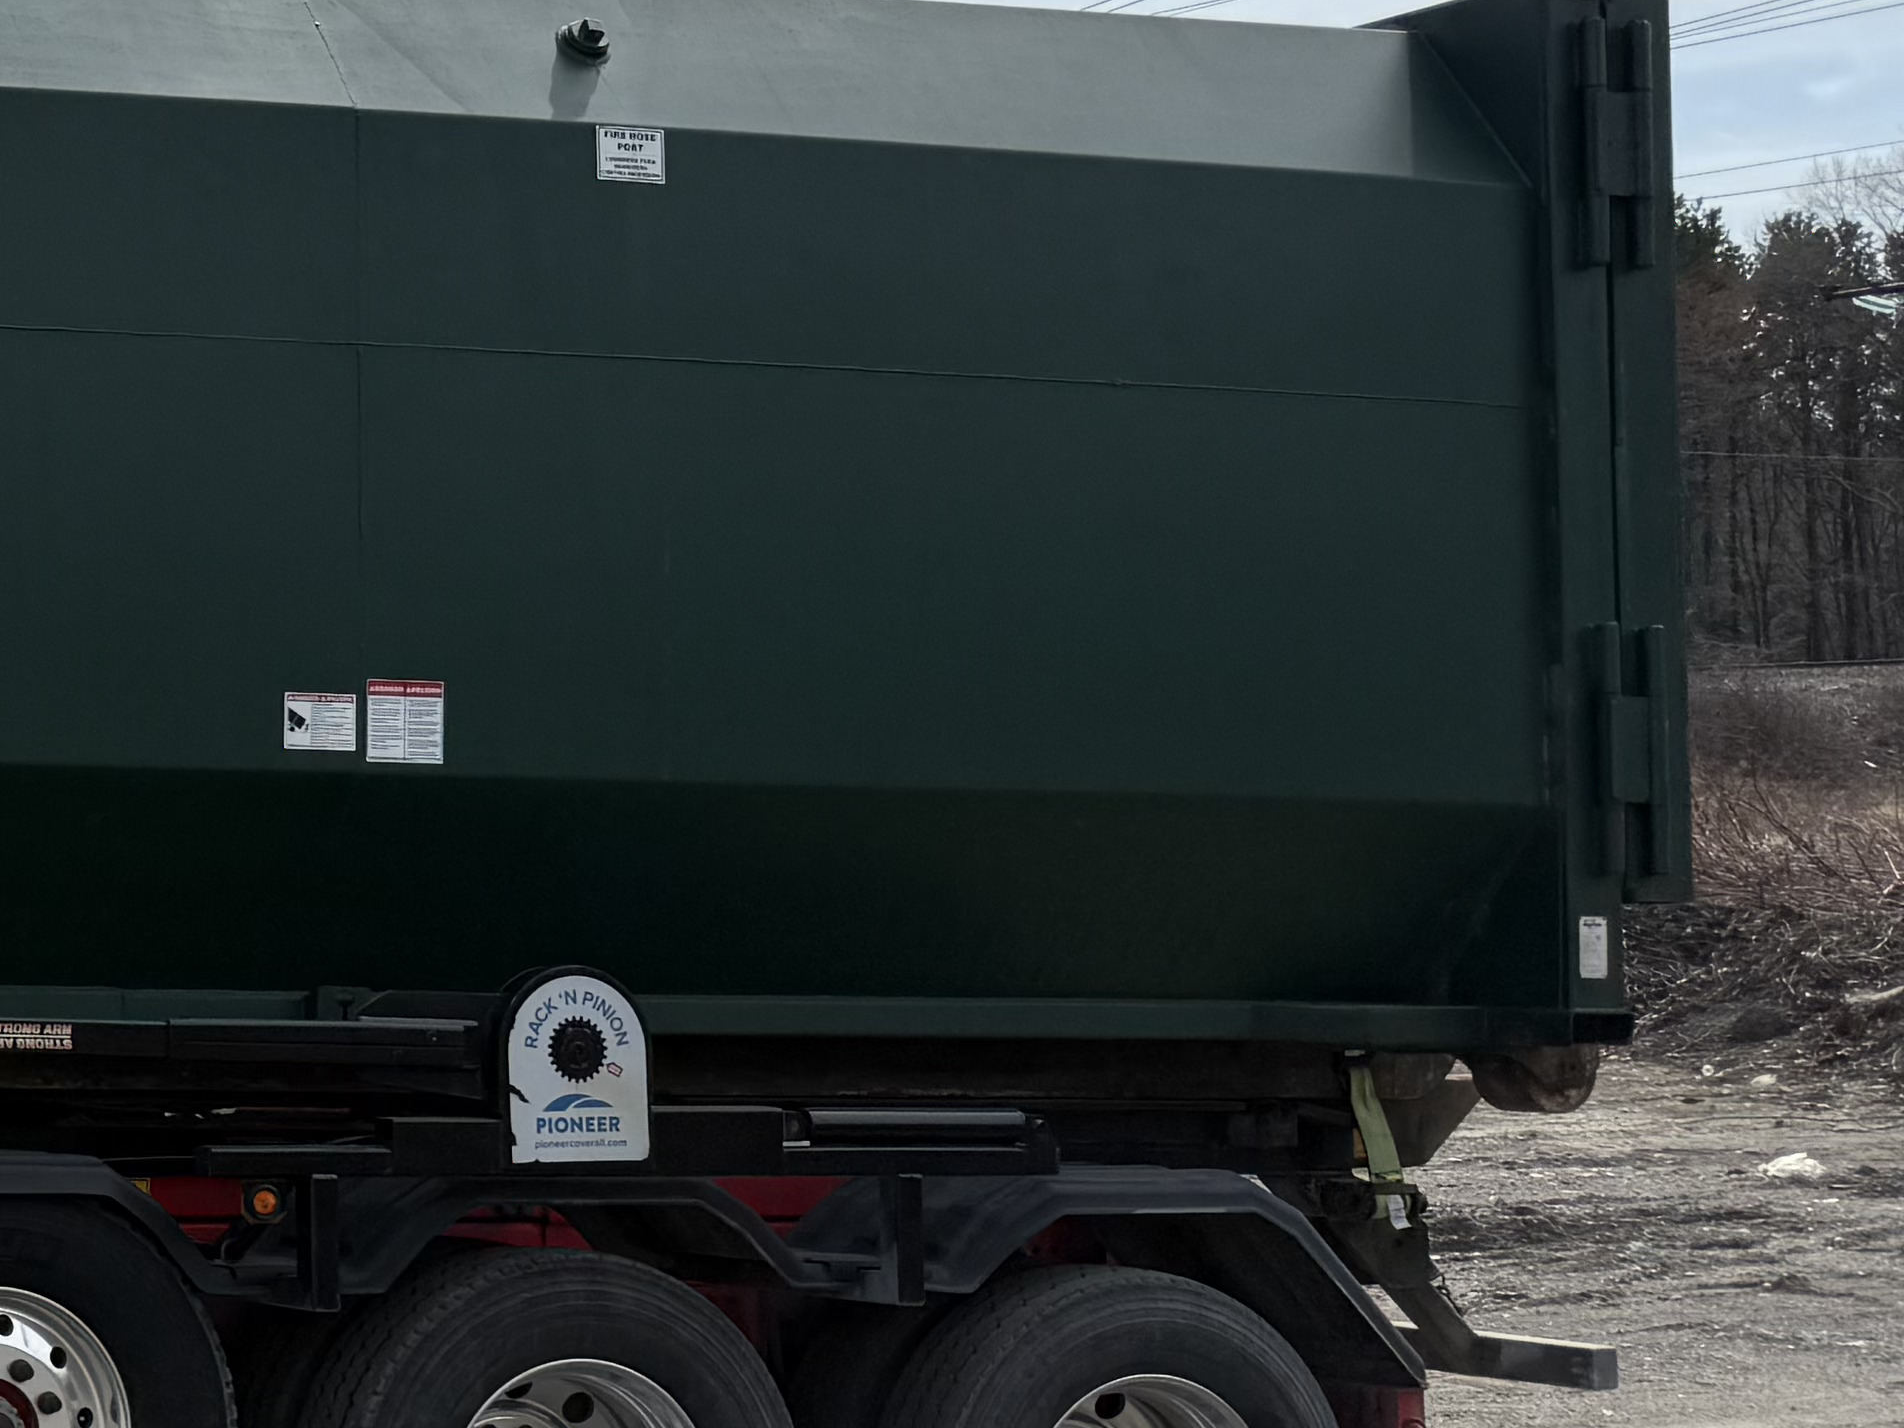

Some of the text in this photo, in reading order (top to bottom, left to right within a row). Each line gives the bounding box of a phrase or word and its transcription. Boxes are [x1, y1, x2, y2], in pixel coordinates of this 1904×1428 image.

[524, 997, 559, 1049] RACK
[582, 991, 629, 1047] PINION
[43, 1024, 73, 1035] ARM
[536, 1116, 621, 1133] PIONEER
